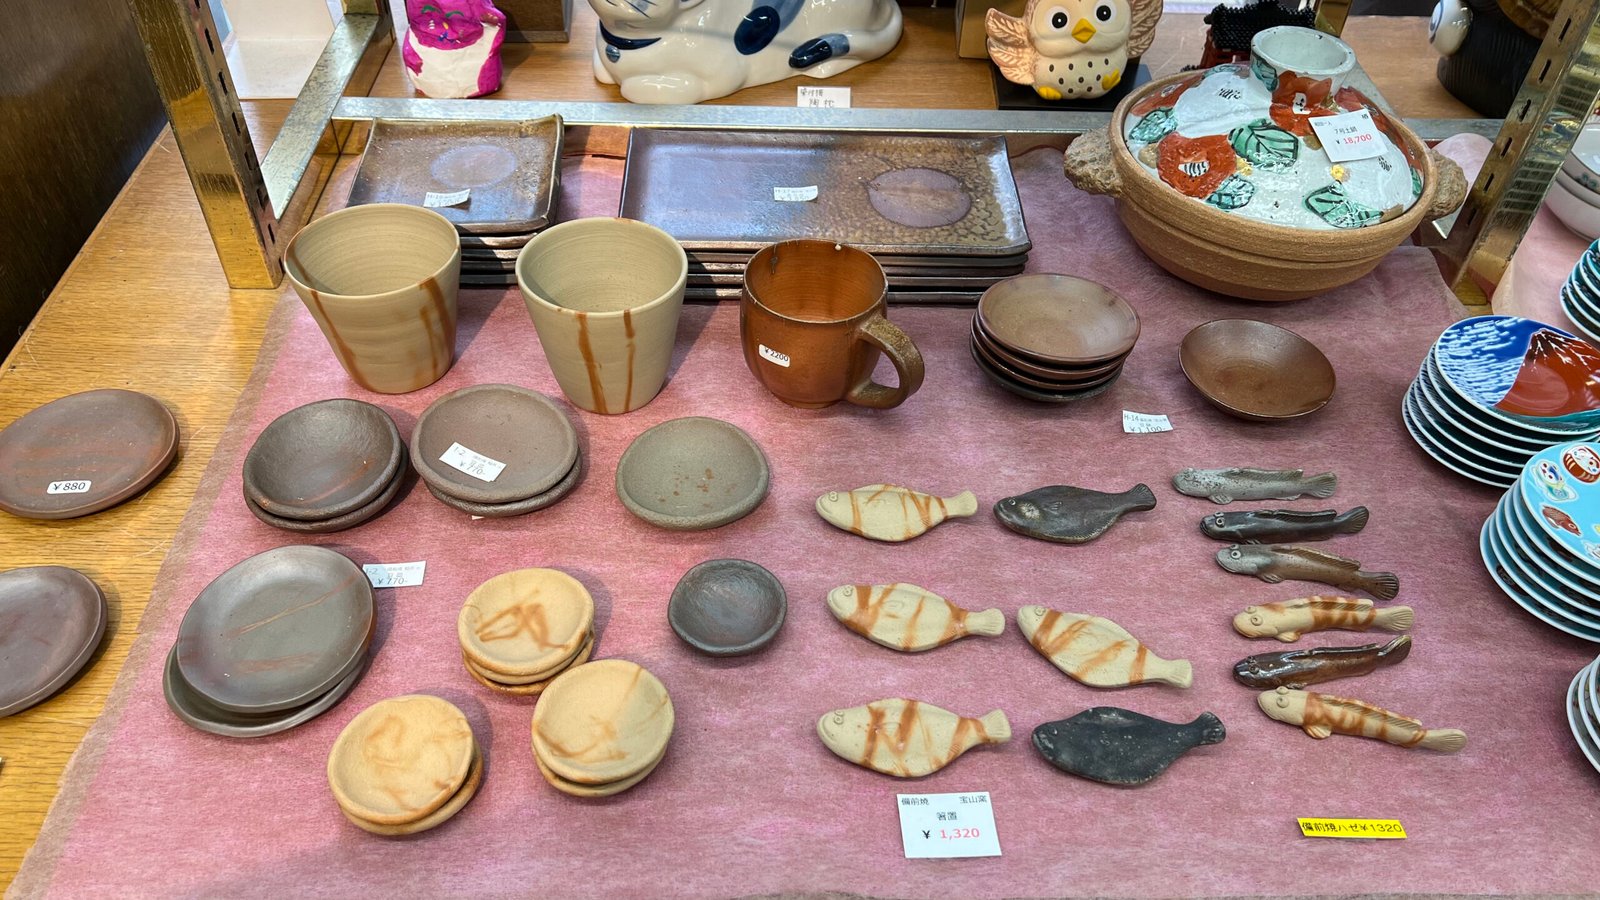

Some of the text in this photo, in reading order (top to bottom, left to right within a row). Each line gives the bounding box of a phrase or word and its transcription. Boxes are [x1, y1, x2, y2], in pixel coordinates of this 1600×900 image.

[1343, 133, 1373, 145] 18,700
[764, 346, 788, 361] ¥2200
[53, 482, 86, 491] ¥880
[901, 797, 930, 806] 備前焼
[939, 827, 980, 840] 1,320
